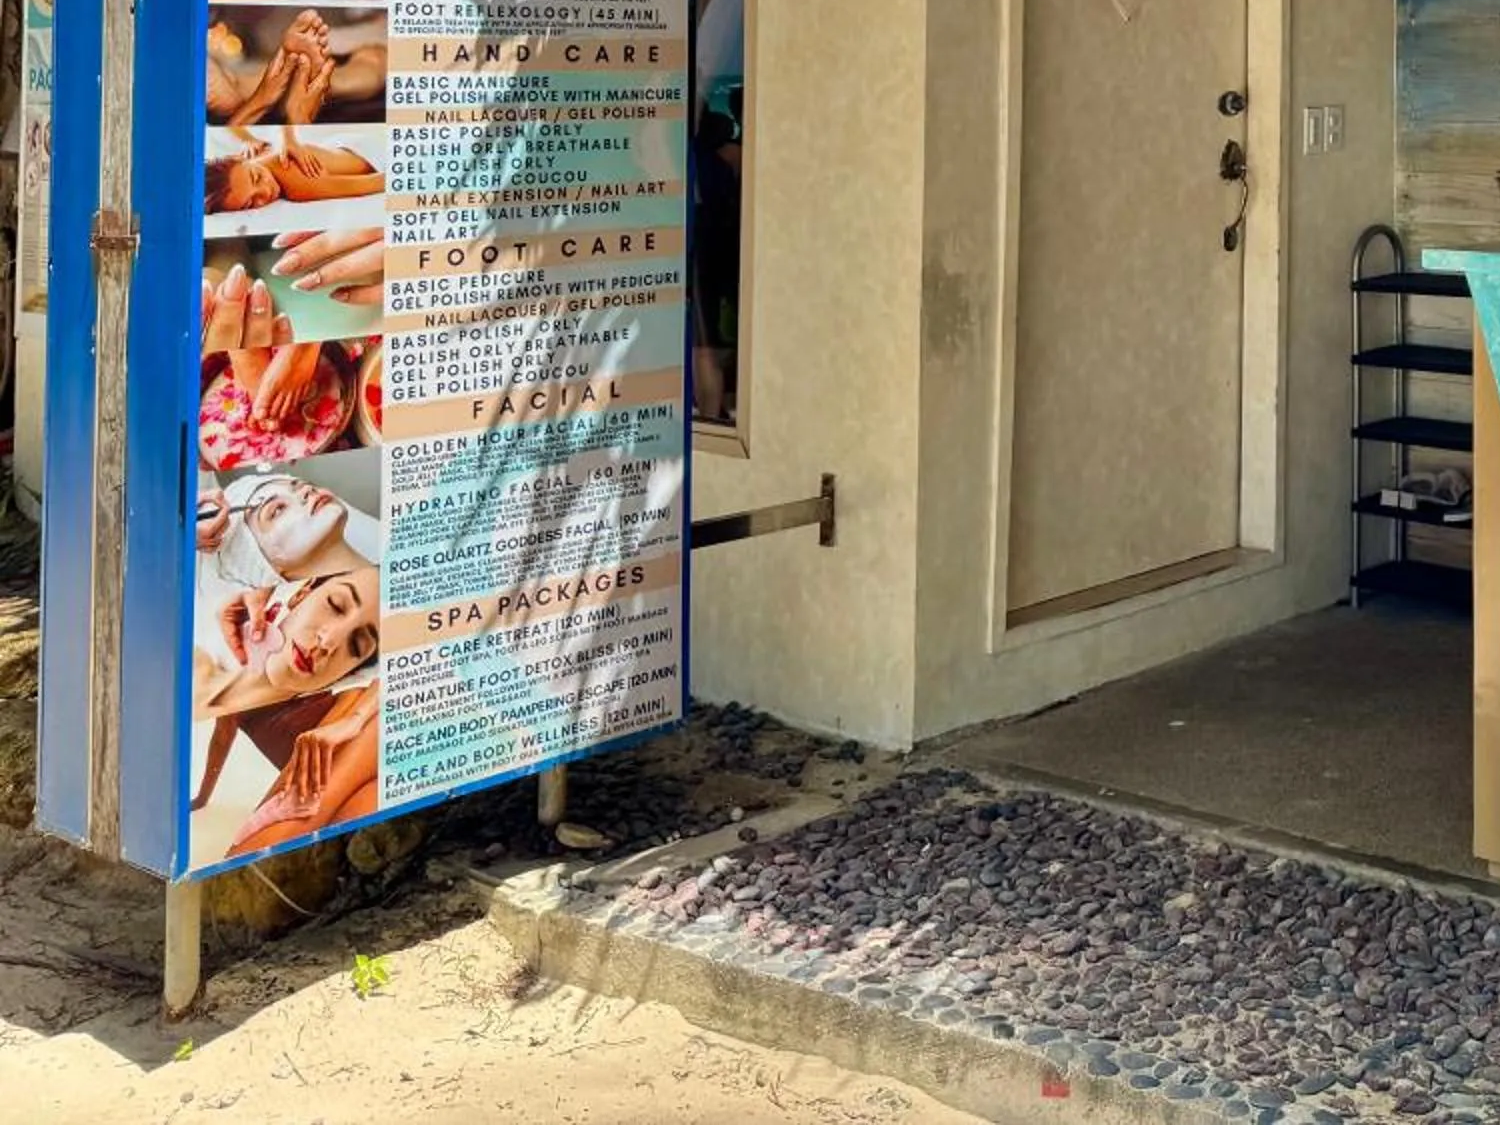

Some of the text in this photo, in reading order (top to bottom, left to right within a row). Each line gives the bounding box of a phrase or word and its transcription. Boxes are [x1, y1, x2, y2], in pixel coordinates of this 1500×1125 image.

[395, 2, 446, 16] FOOT
[455, 3, 581, 21] REFLEXOLOGY
[423, 43, 659, 63] HAND CARE
[392, 88, 681, 104] GEL POLISH REMOVE WITH MANICURE
[393, 76, 550, 90] BASIC MANICURE
[425, 106, 657, 123] NAIL LACQUER GEL POLISH
[393, 123, 583, 140] BASIC POLISH ORLY
[393, 143, 461, 158] POLISH
[526, 136, 632, 153] BREATHABLE
[391, 156, 556, 175] GEL POLISH ORLY
[391, 170, 588, 192] GEL POLISH COUCOU
[416, 181, 666, 206] NAIL EXTENSION NAIL ART
[393, 201, 621, 226] SOFT GEL NAIL EXTENSION
[392, 226, 479, 243] NAIL ART
[419, 233, 655, 269] FOOT CARE
[391, 270, 545, 295] BASIC PEDICURE
[391, 297, 424, 310] GEL
[431, 290, 490, 307] POLISH
[497, 283, 562, 300] REMOVE
[568, 277, 606, 293] WITH
[425, 292, 657, 327] NAIL LACQUER GEL POLISH
[391, 332, 449, 349] BASIC
[459, 325, 523, 341] POLISH
[391, 328, 630, 367] POLISH ORLY BREATHABLE
[391, 352, 555, 384] GEL POLISH ORLY
[392, 363, 589, 401] GEL POLISH COUCOU
[473, 381, 620, 419] FACIAL
[391, 437, 468, 460] GOLDEN
[477, 429, 525, 446] HOUR
[391, 476, 574, 517] HYDRATING FACIAL
[390, 555, 429, 574] ROSE
[433, 543, 491, 564] QUARTZ
[428, 602, 482, 631] SPA
[498, 566, 645, 616] PACKAGES
[387, 650, 433, 671] FOOT
[439, 638, 481, 659] CARE
[486, 620, 551, 647] RETREAT
[385, 679, 474, 712] SIGNATURE
[479, 667, 520, 688] FOOT
[525, 654, 573, 675] DETOX
[576, 643, 615, 662] BLISS
[385, 679, 626, 755] FACE AND BODY PAMPERING ESCAPE
[385, 716, 599, 788] FACE AND BODY WELLNESS
